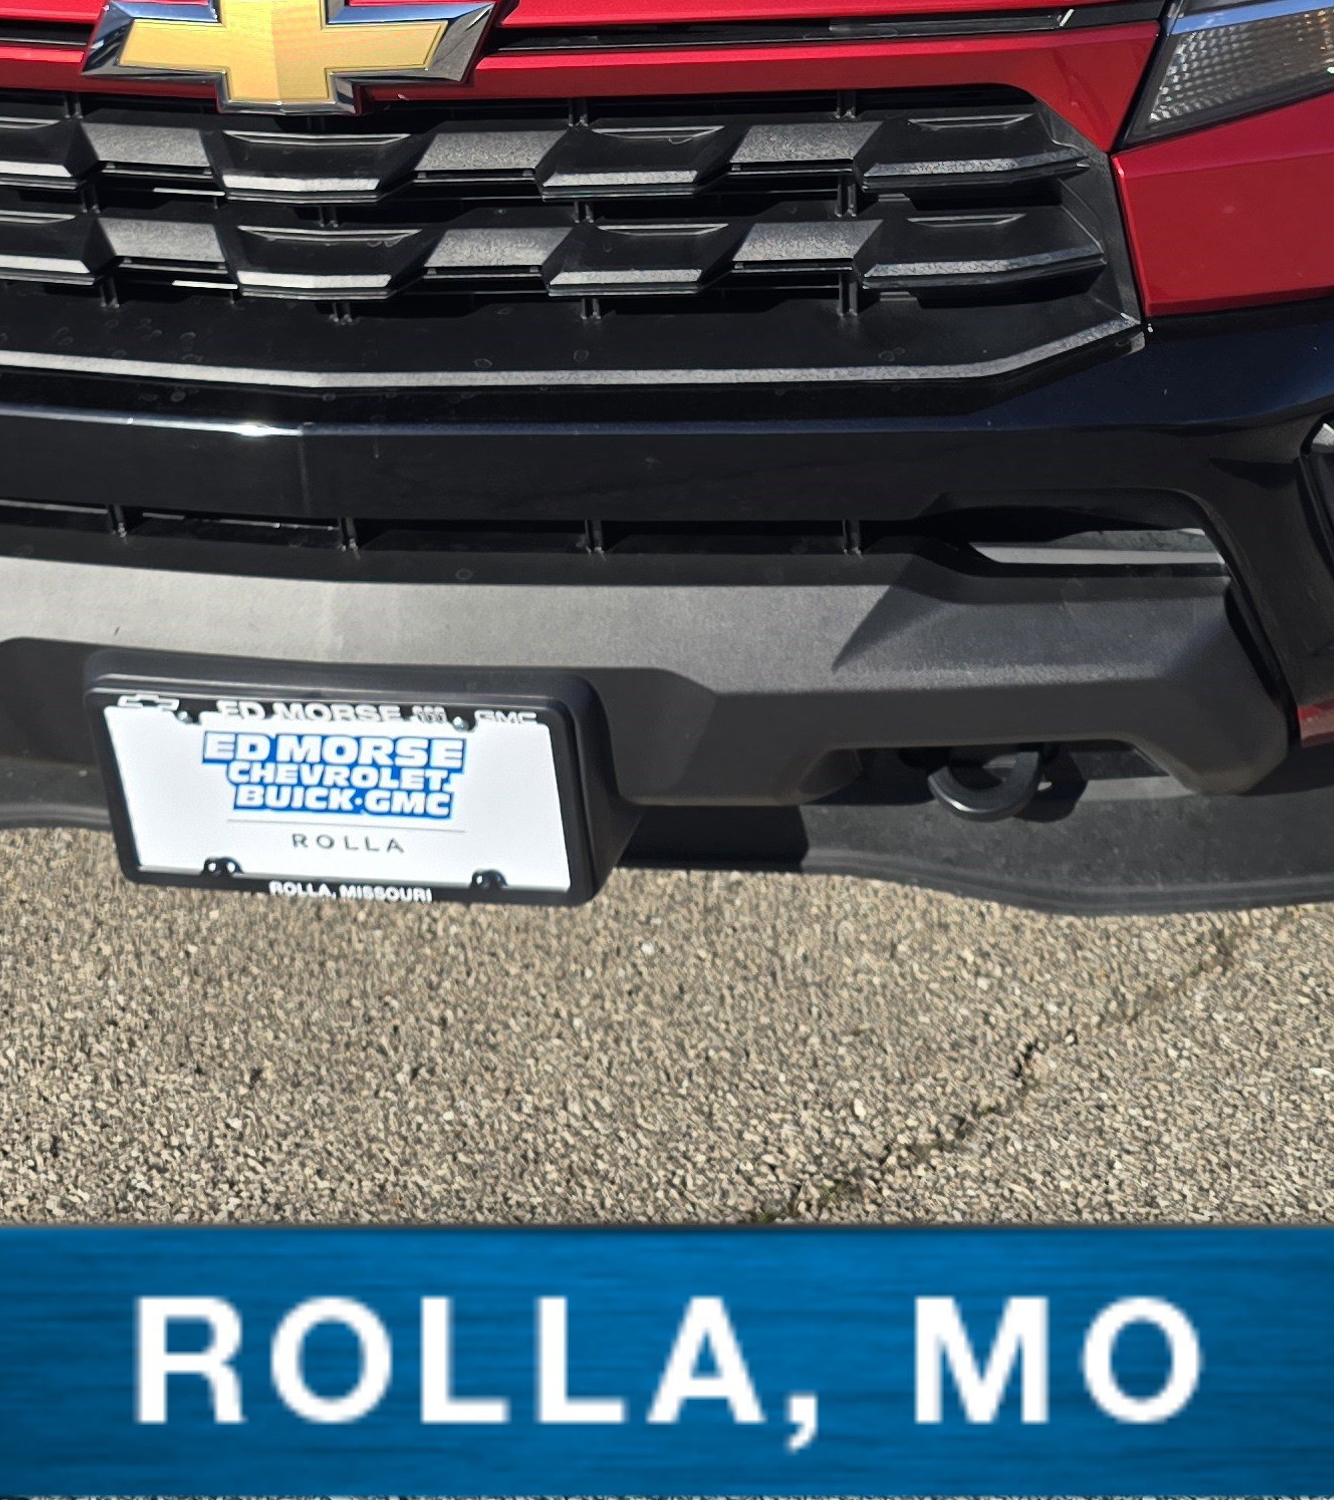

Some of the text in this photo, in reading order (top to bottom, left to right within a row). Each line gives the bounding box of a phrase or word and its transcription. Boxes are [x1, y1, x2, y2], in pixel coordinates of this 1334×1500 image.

[217, 700, 266, 719] ED
[273, 702, 402, 723] MORSE
[204, 731, 464, 769] ED MORSE
[228, 760, 449, 792] CHEVROLET
[291, 832, 405, 853] ROLLA
[269, 879, 433, 903] ROLLA, MISSOURI
